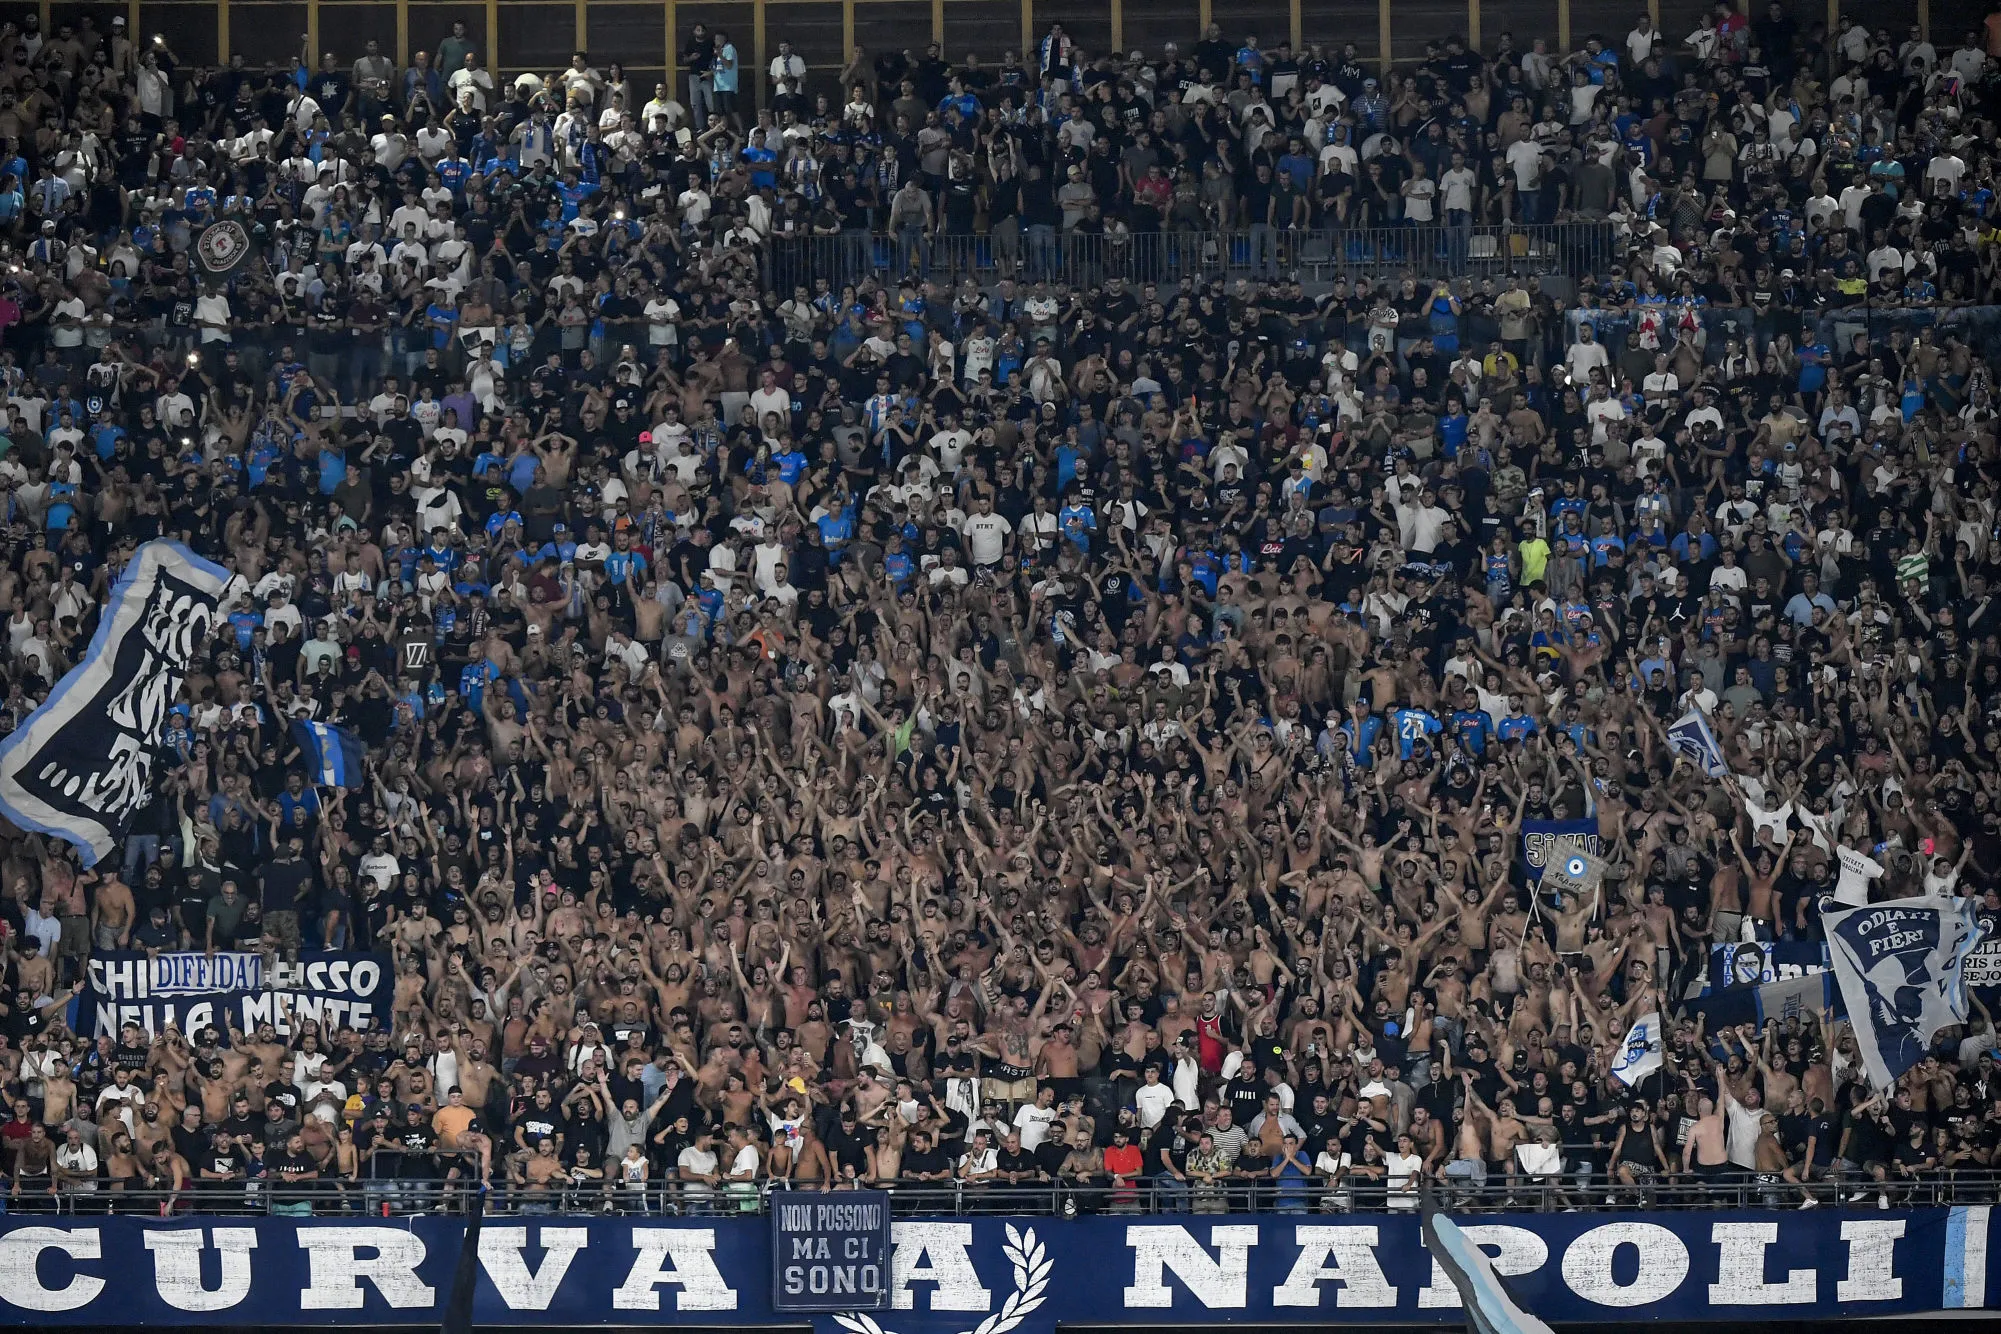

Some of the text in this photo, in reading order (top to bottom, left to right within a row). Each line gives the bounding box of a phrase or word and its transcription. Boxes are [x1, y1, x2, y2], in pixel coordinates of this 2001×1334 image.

[1261, 543, 1284, 554] Lete
[612, 559, 635, 577] 10
[1401, 717, 1425, 739] 20
[1462, 719, 1479, 727] Lete
[1857, 911, 1932, 936] ODIATI
[1889, 922, 1900, 933] E
[1868, 929, 1924, 956] FIERI
[87, 958, 148, 1000] CHI
[156, 955, 264, 989] DIFFIDAT
[242, 991, 373, 1041] MENTE
[781, 1203, 881, 1232] NON POSSONO
[792, 1237, 869, 1260] MA CI
[0, 1226, 738, 1311] CURVA
[1123, 1219, 1906, 1309] NAPOLI
[785, 1265, 879, 1294] SONO
